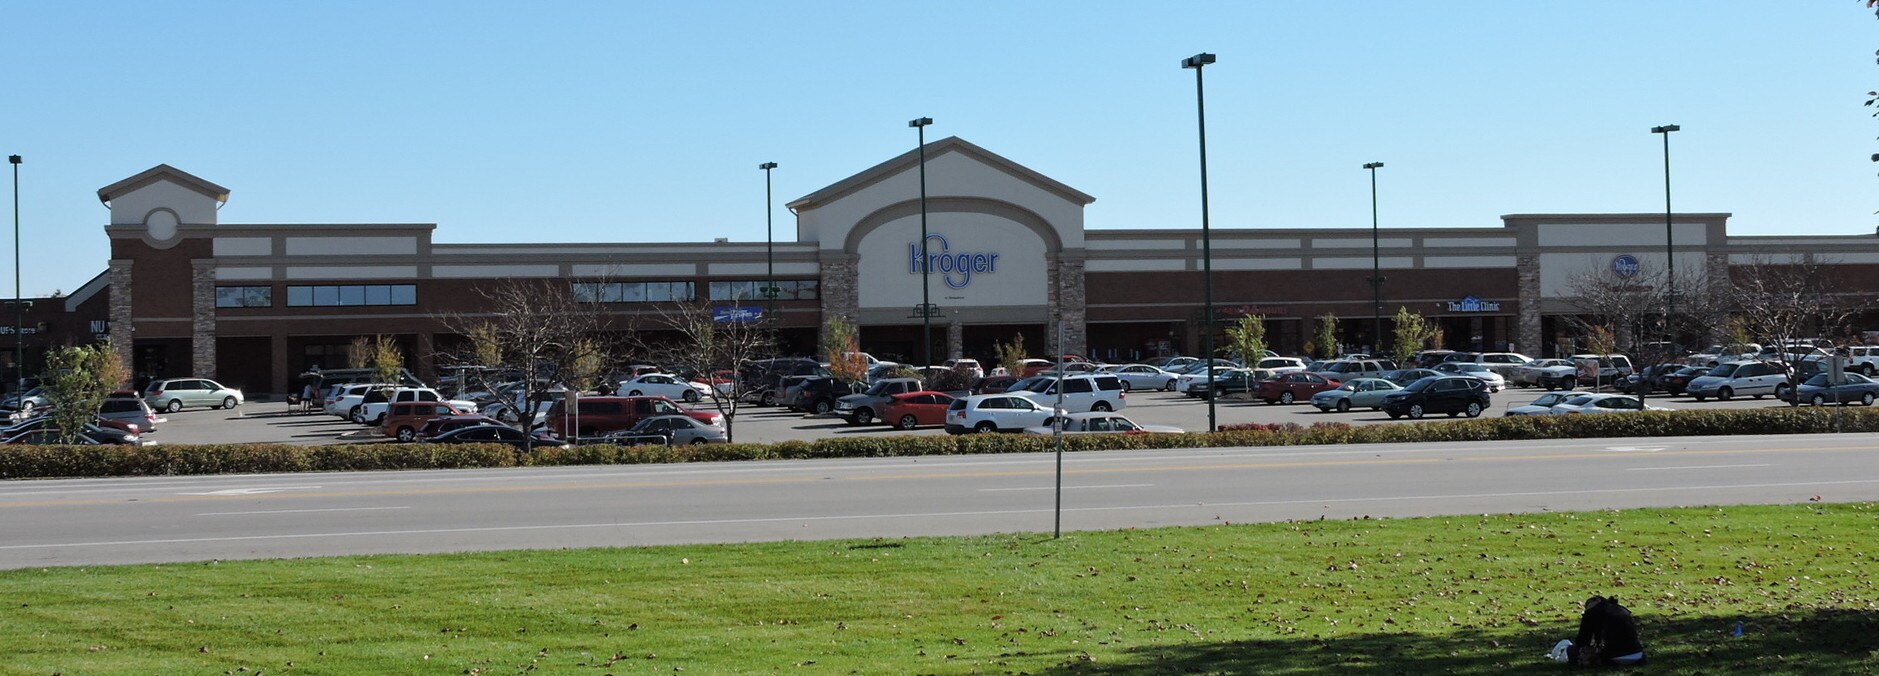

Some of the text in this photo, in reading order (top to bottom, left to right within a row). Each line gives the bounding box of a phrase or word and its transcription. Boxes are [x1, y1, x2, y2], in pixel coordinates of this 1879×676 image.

[909, 233, 999, 289] Kroger
[1448, 301, 1499, 311] The Little Clinic
